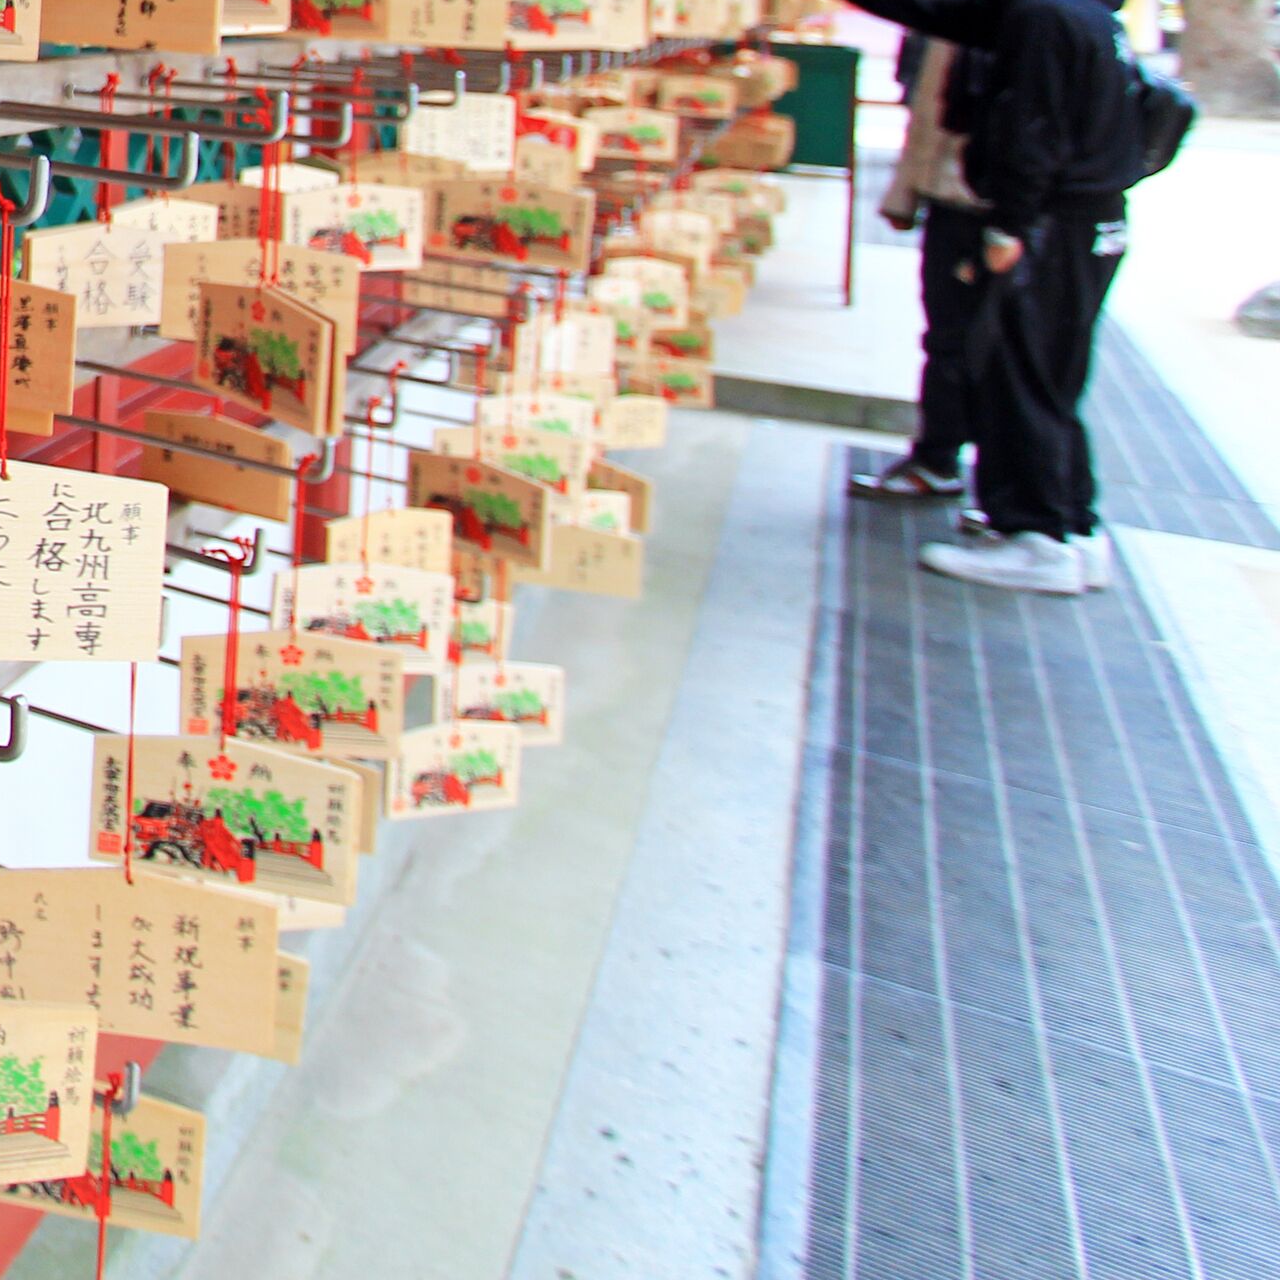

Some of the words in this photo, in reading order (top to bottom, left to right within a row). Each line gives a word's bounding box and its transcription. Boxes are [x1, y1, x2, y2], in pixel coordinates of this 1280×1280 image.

[80, 239, 120, 316] 合格
[25, 482, 80, 651] に合格します
[66, 502, 114, 657] 北九州高専
[119, 502, 143, 546] 願事
